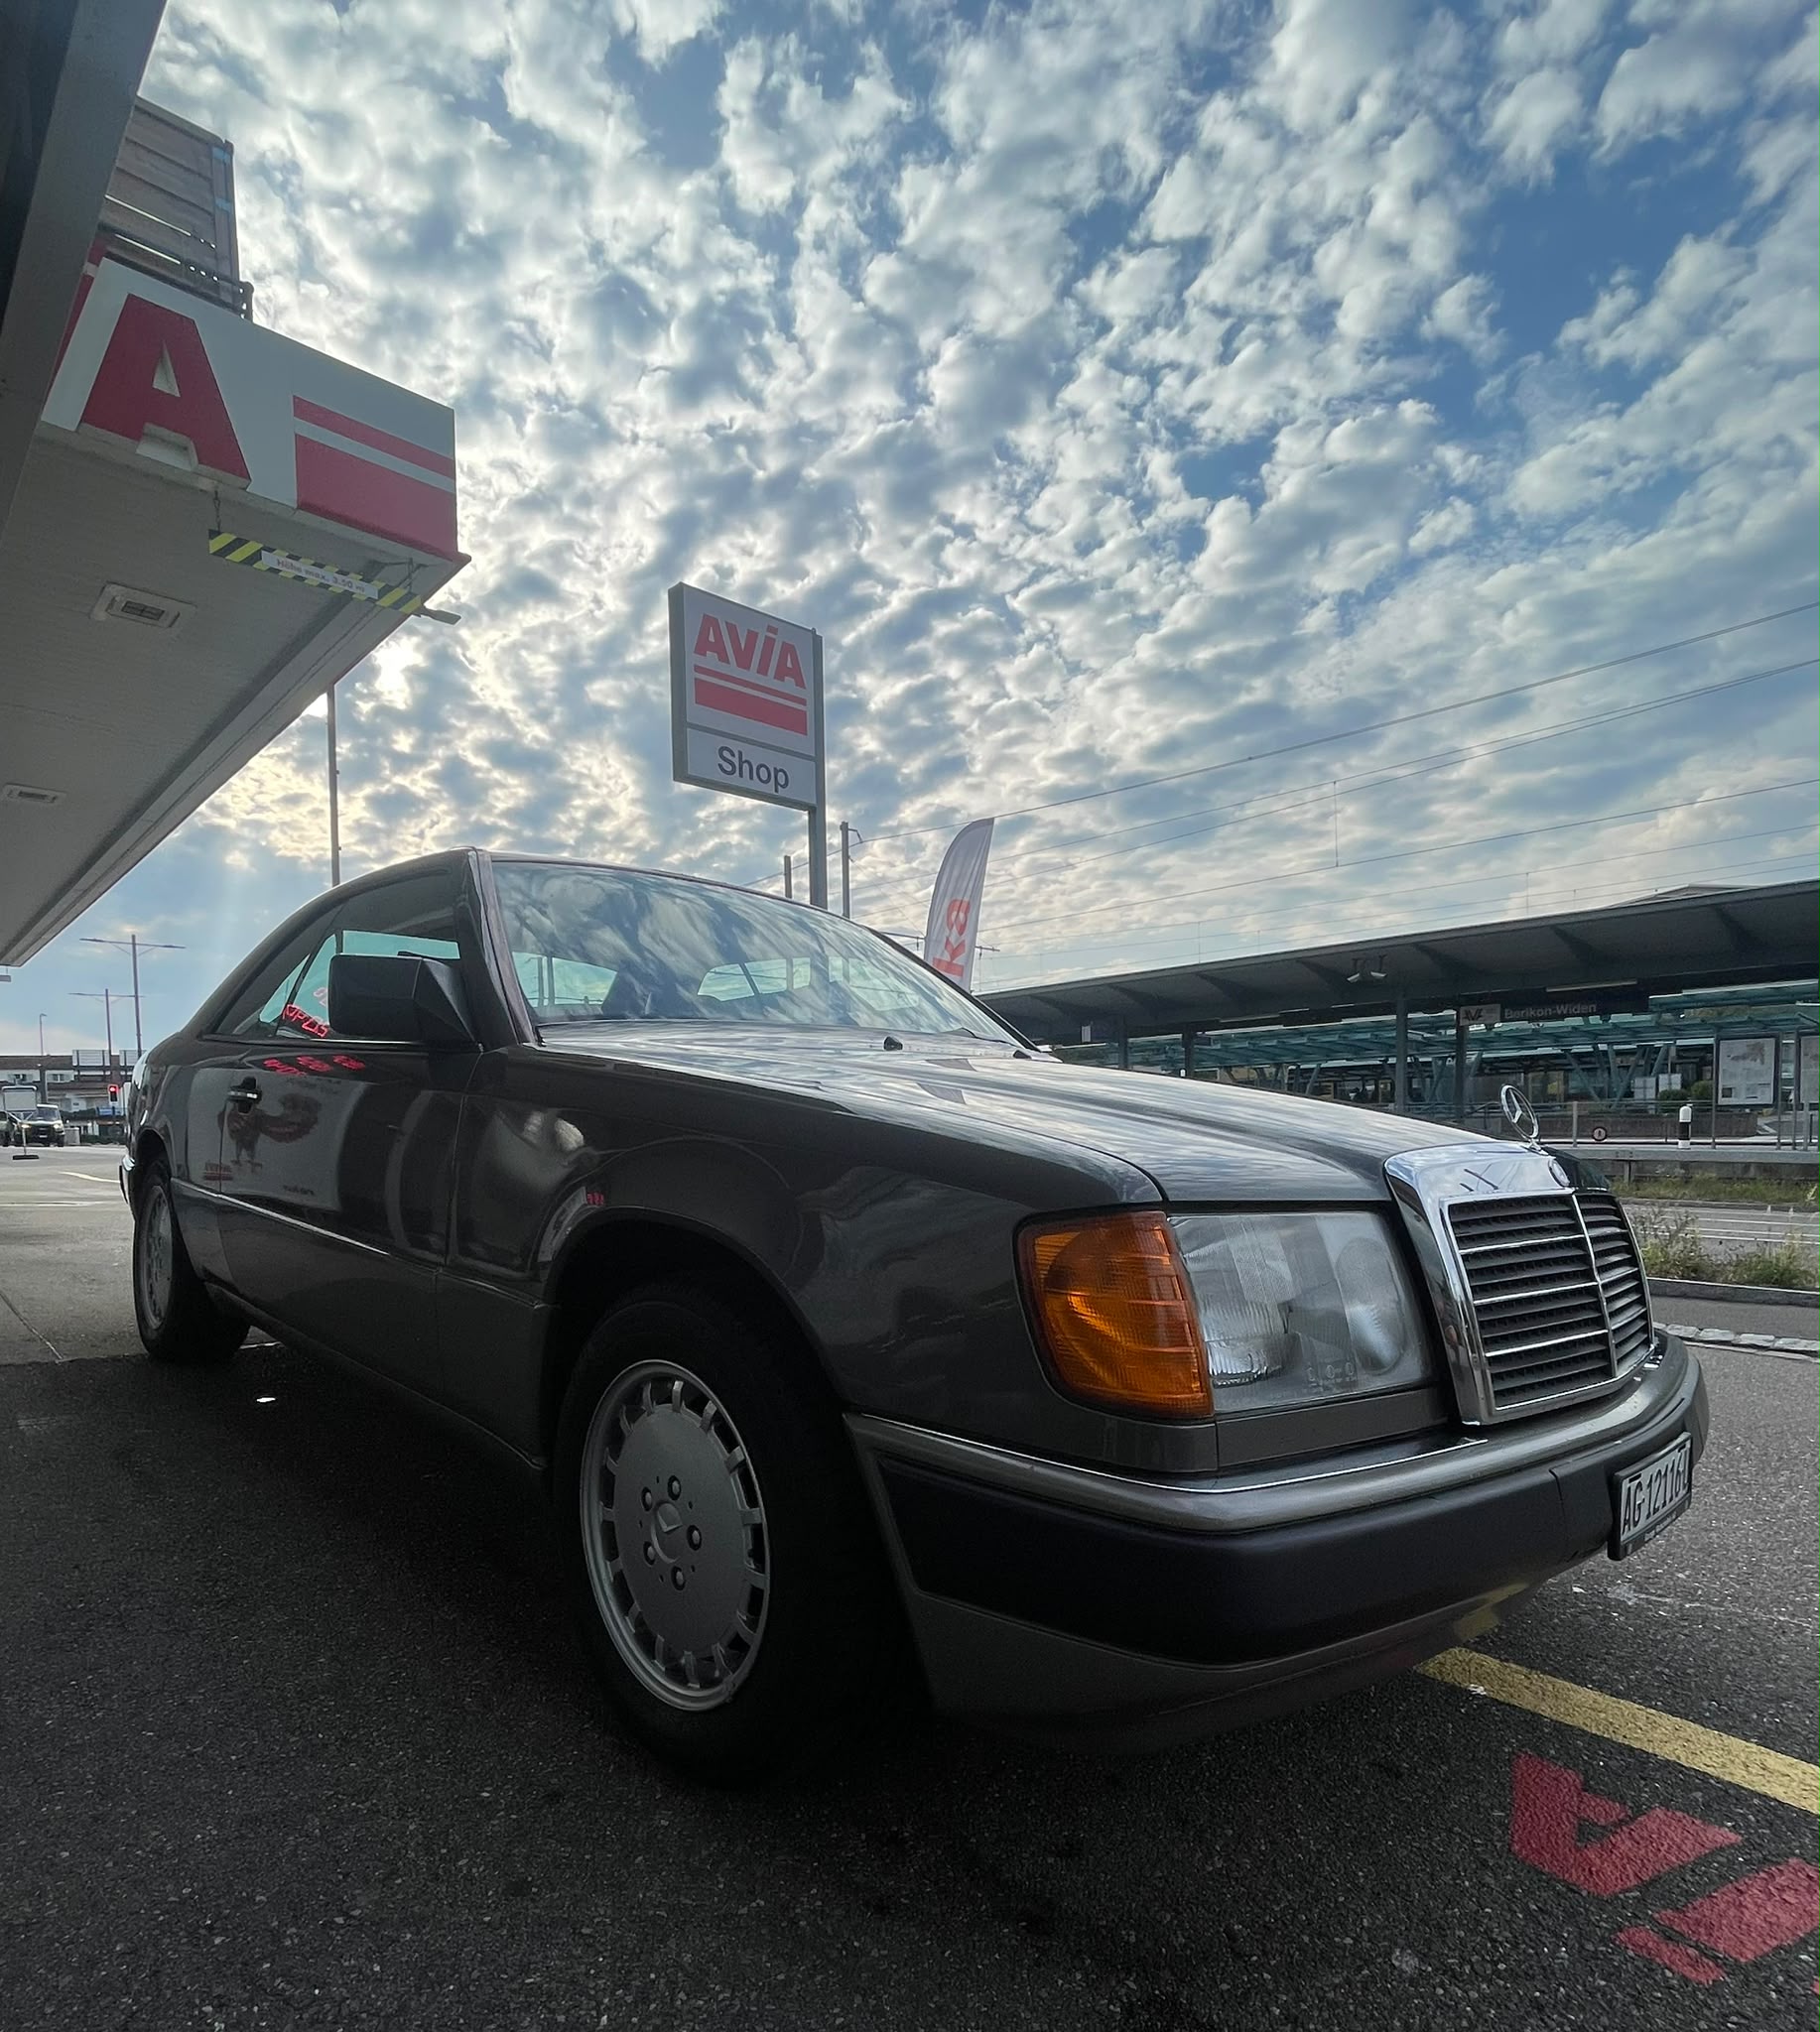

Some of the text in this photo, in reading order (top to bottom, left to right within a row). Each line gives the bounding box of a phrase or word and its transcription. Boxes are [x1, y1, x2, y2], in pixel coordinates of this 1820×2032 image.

[50, 250, 252, 483] A
[717, 745, 790, 794] Shop
[1503, 1002, 1597, 1020] Berikon-Widen
